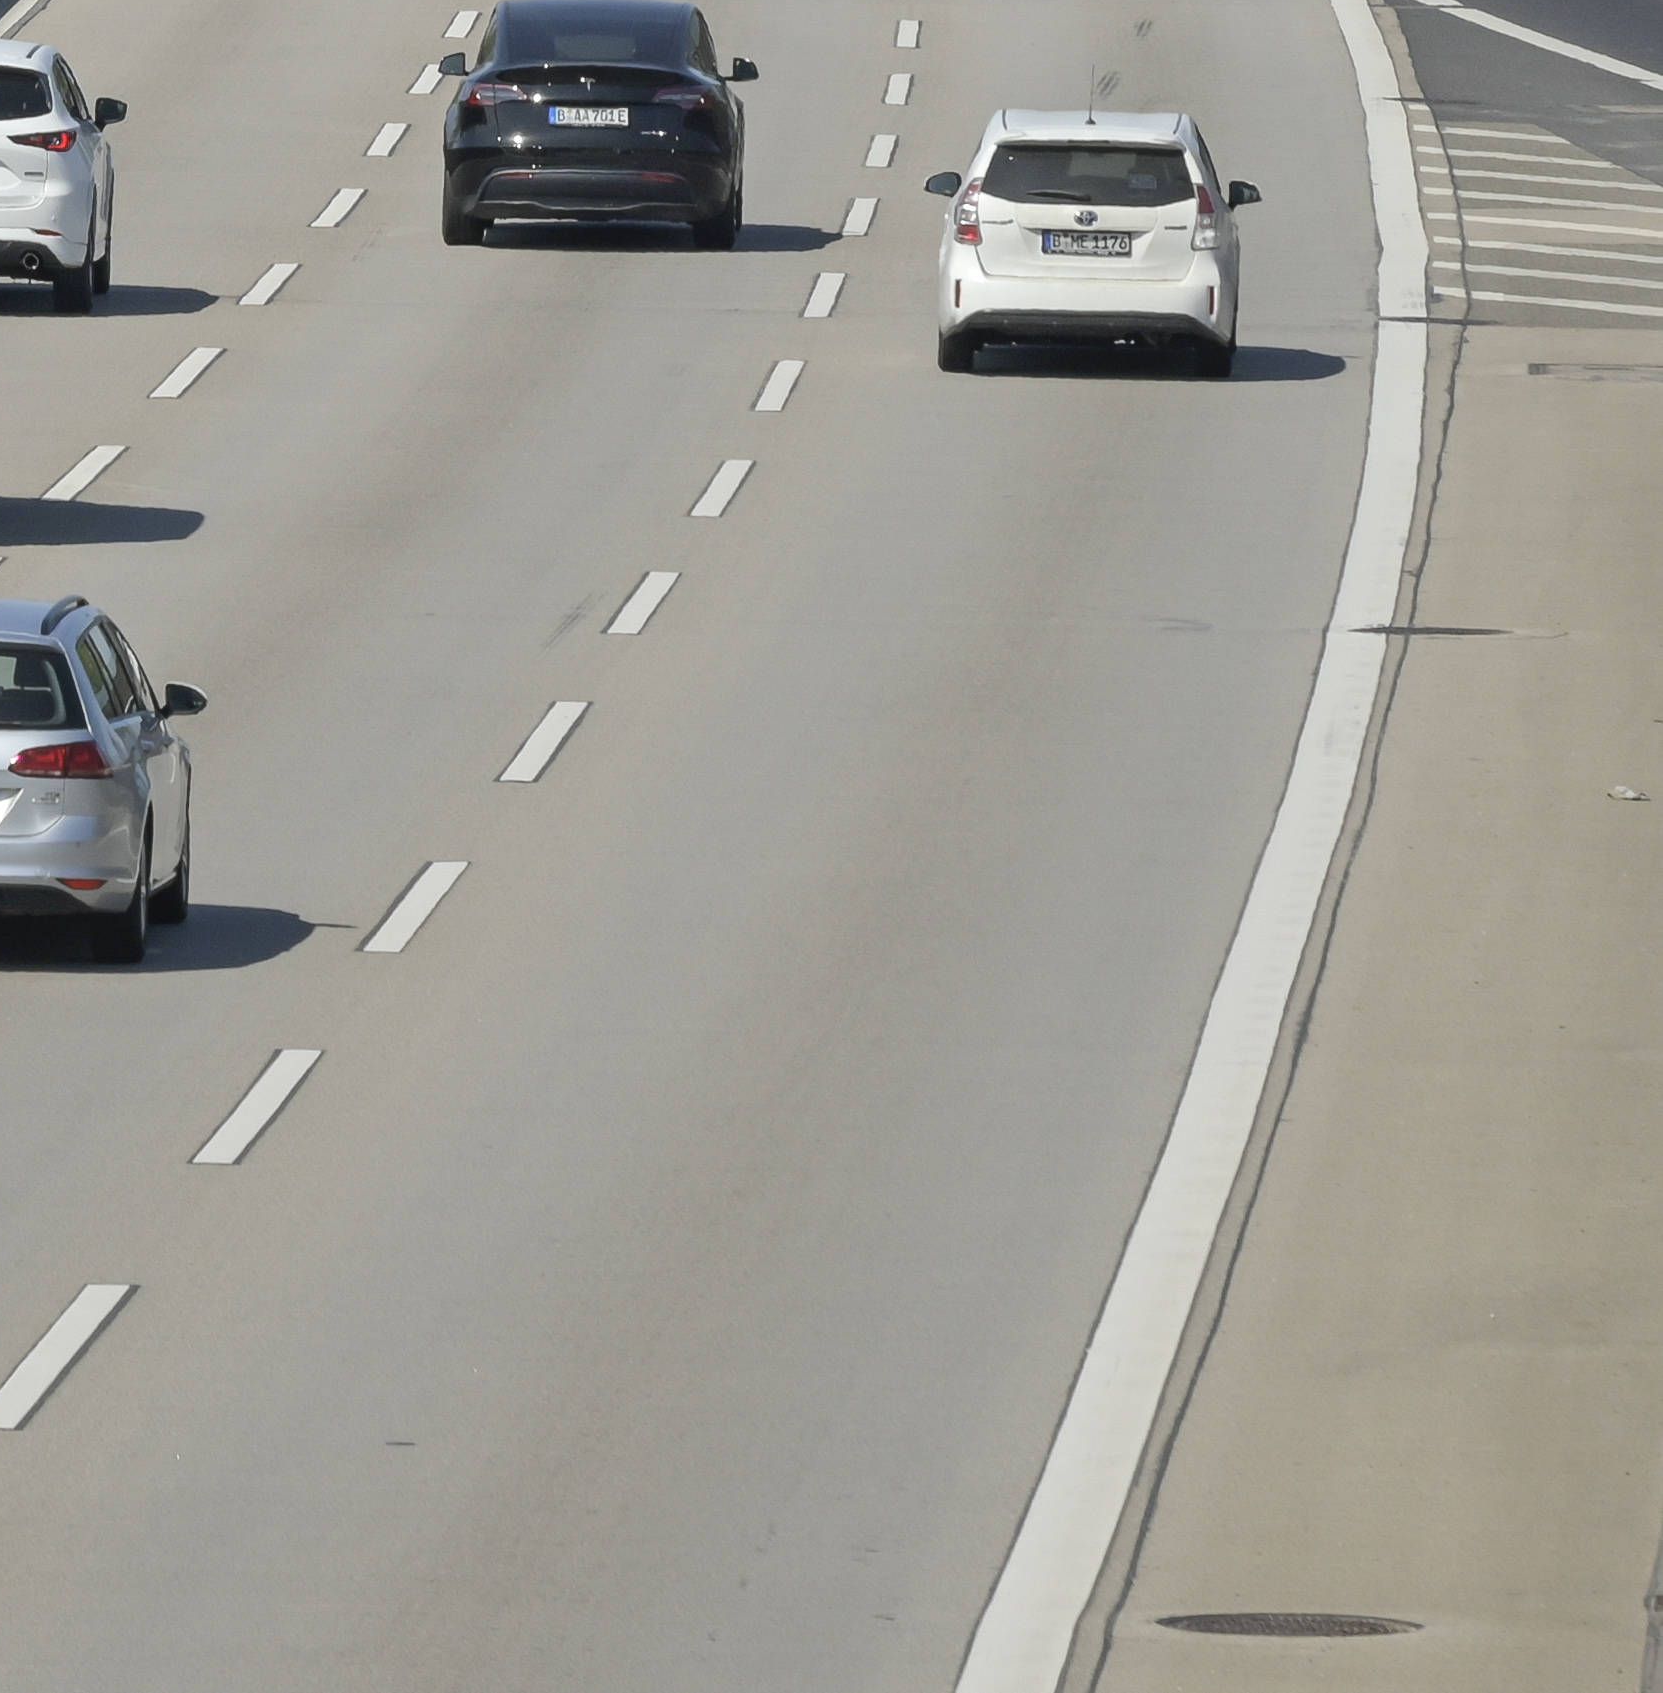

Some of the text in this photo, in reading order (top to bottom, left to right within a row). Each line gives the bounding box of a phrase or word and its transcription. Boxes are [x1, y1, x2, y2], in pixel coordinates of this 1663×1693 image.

[557, 108, 566, 122] B
[573, 108, 589, 123] AA
[1052, 233, 1128, 250] B ME 1176
